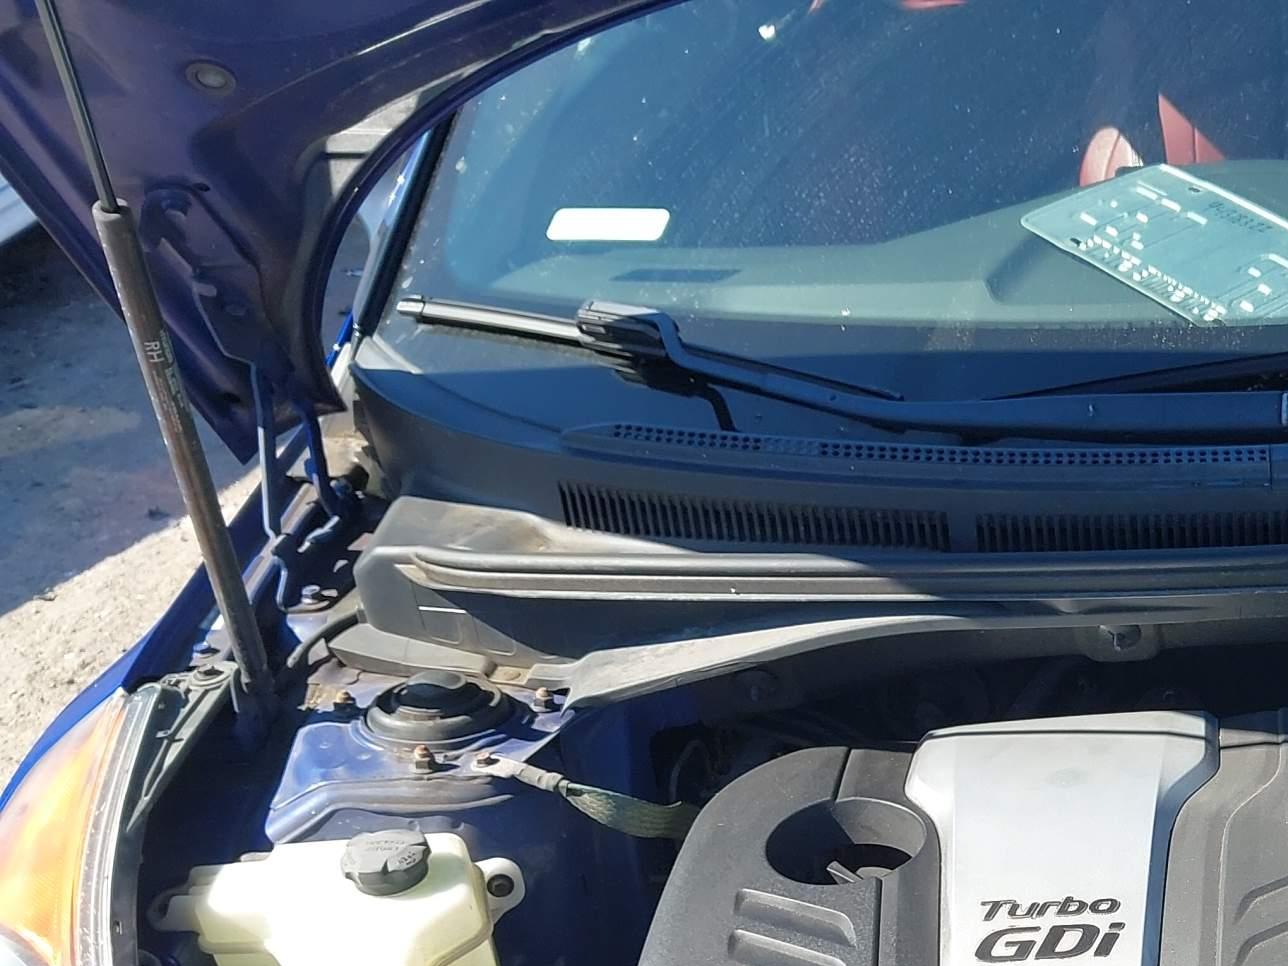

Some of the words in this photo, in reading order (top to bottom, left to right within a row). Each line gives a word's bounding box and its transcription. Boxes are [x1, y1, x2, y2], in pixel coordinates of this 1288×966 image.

[144, 341, 163, 362] RH
[980, 896, 1121, 922] Turbo
[974, 922, 1126, 963] GDi
